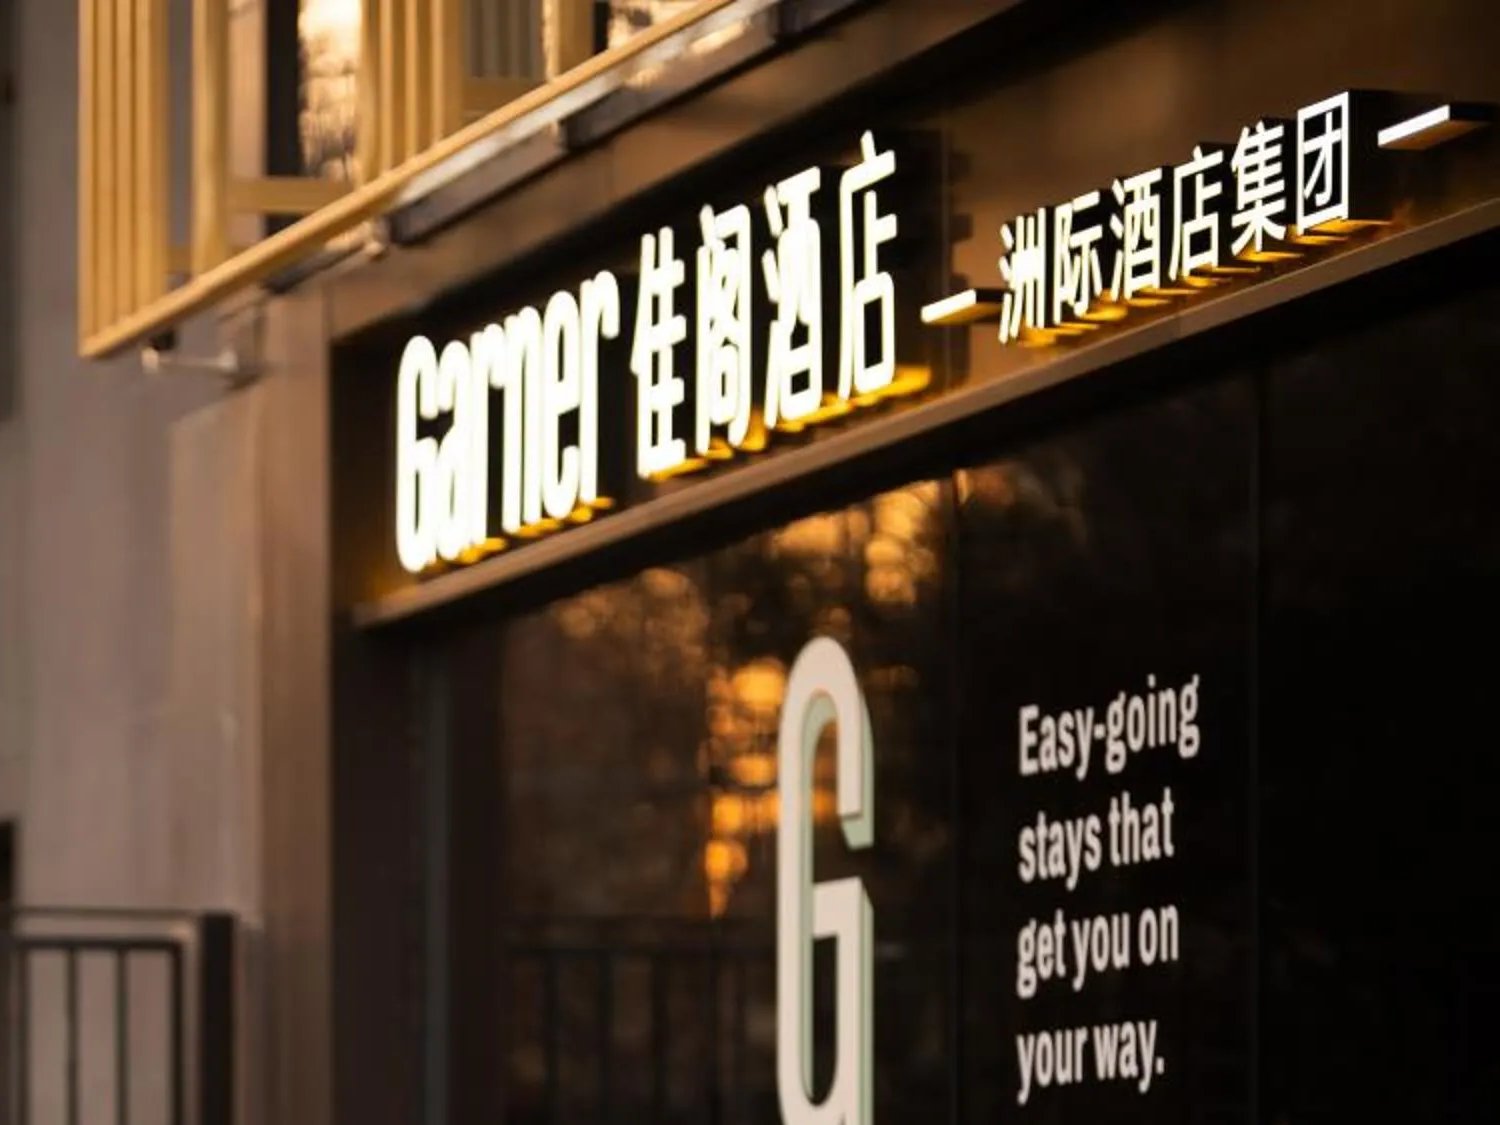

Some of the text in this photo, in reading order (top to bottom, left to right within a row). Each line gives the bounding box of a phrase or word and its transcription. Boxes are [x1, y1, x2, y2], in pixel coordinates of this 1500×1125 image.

[998, 91, 1350, 344] 洲际酒店集团
[630, 130, 898, 478] 佳阁酒店
[396, 270, 620, 573] Garner
[1018, 673, 1201, 782] Easy-going
[1018, 787, 1175, 891] stays that
[1016, 904, 1179, 999] get you on
[1016, 1020, 1165, 1105] your way.
